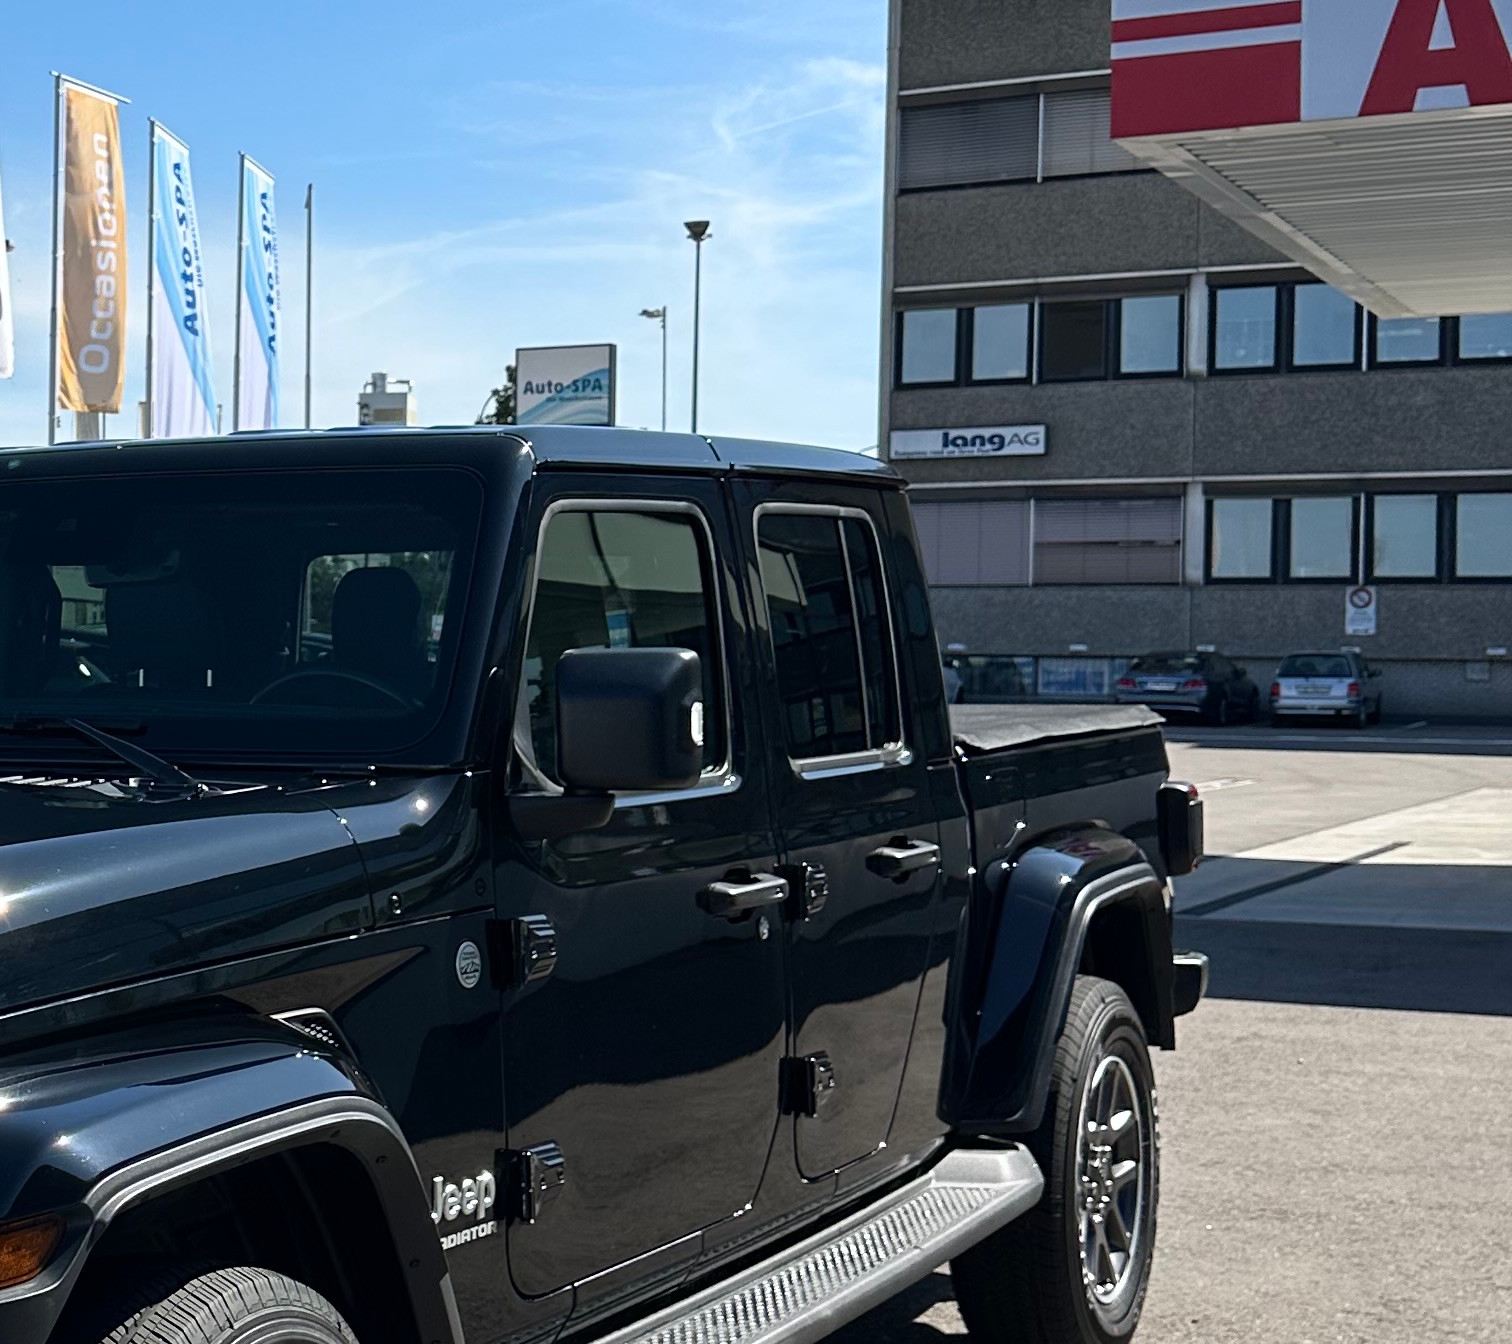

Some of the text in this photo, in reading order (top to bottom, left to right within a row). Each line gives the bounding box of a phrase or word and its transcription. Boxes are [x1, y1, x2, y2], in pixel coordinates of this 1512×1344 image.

[172, 161, 200, 338] Auto-SPA
[523, 377, 603, 395] Auto-SPA
[430, 1169, 496, 1225] Jeep
